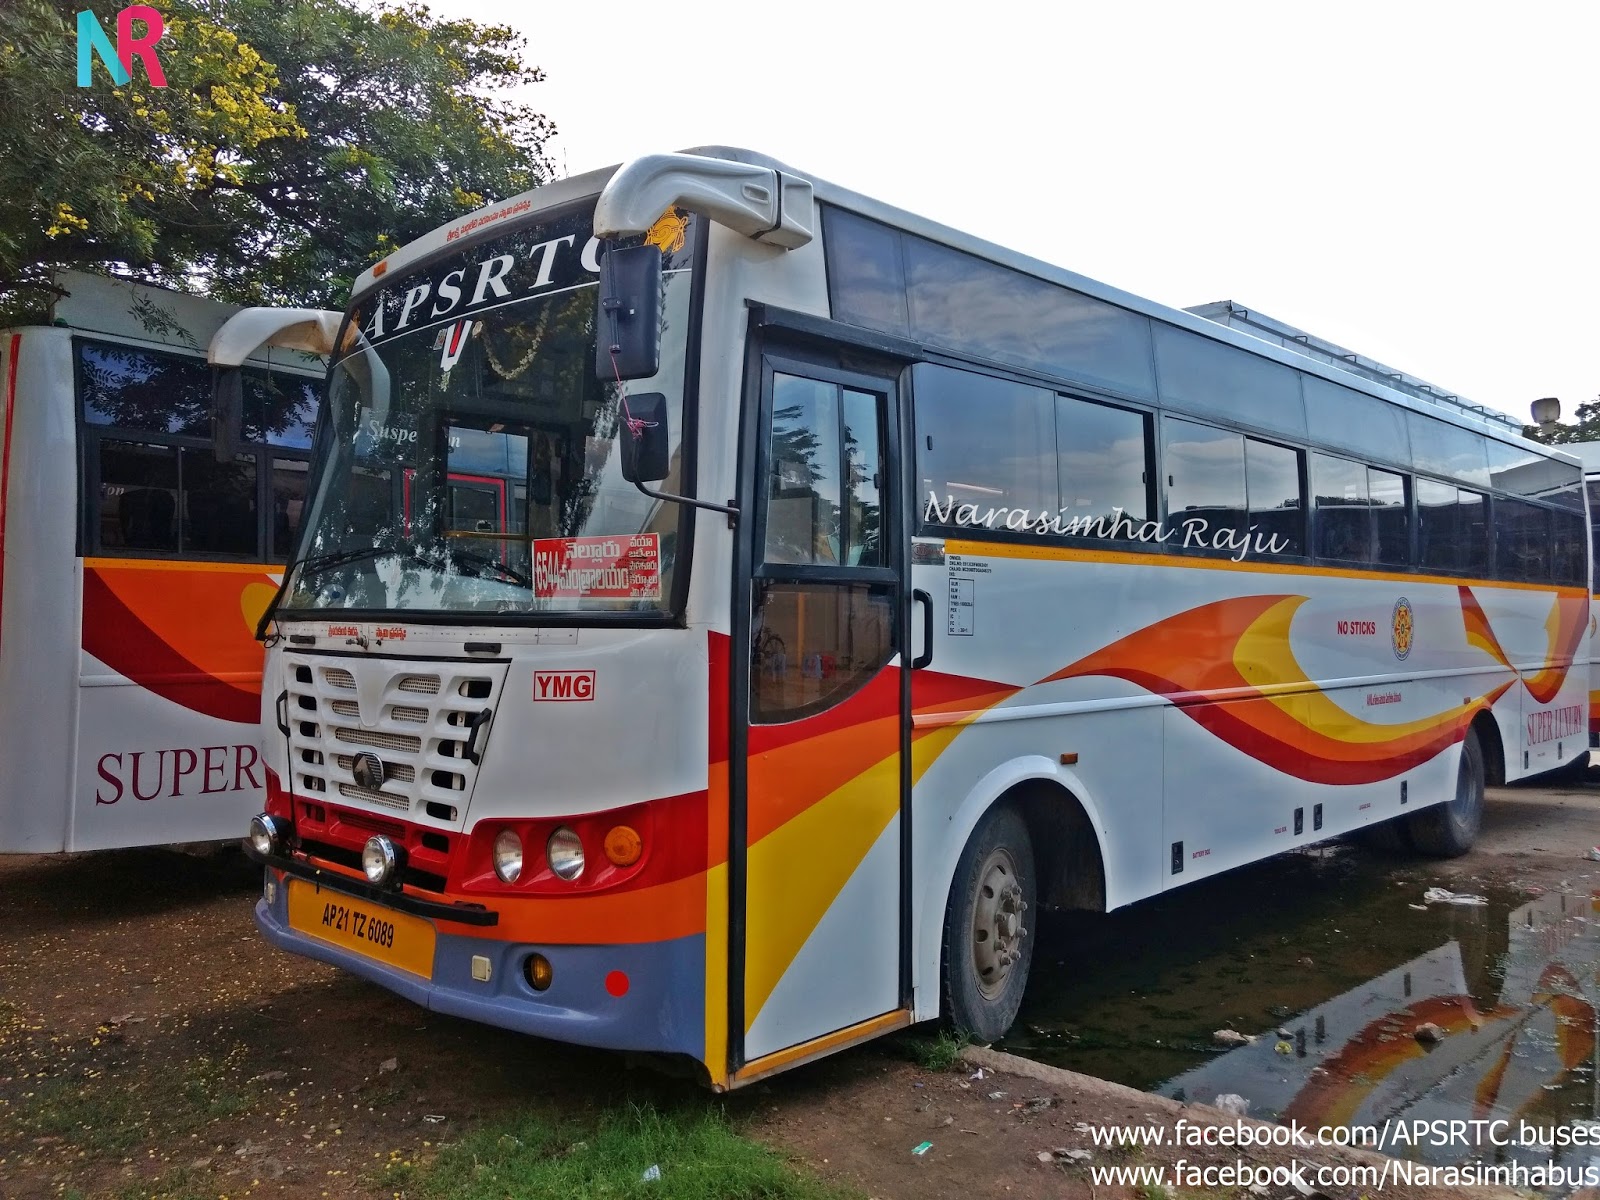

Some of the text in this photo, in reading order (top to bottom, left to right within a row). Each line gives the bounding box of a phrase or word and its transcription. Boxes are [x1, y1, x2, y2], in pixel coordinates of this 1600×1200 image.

[565, 540, 621, 563] నెల్లూరు
[536, 551, 560, 591] 6544
[560, 562, 630, 595] మంత్రాలయం
[1338, 621, 1376, 635] NO STICKS
[537, 675, 591, 698] YMG
[1527, 710, 1553, 746] SUPER
[96, 744, 263, 806] SUPER
[353, 911, 367, 938] TZ
[368, 917, 394, 948] 6089
